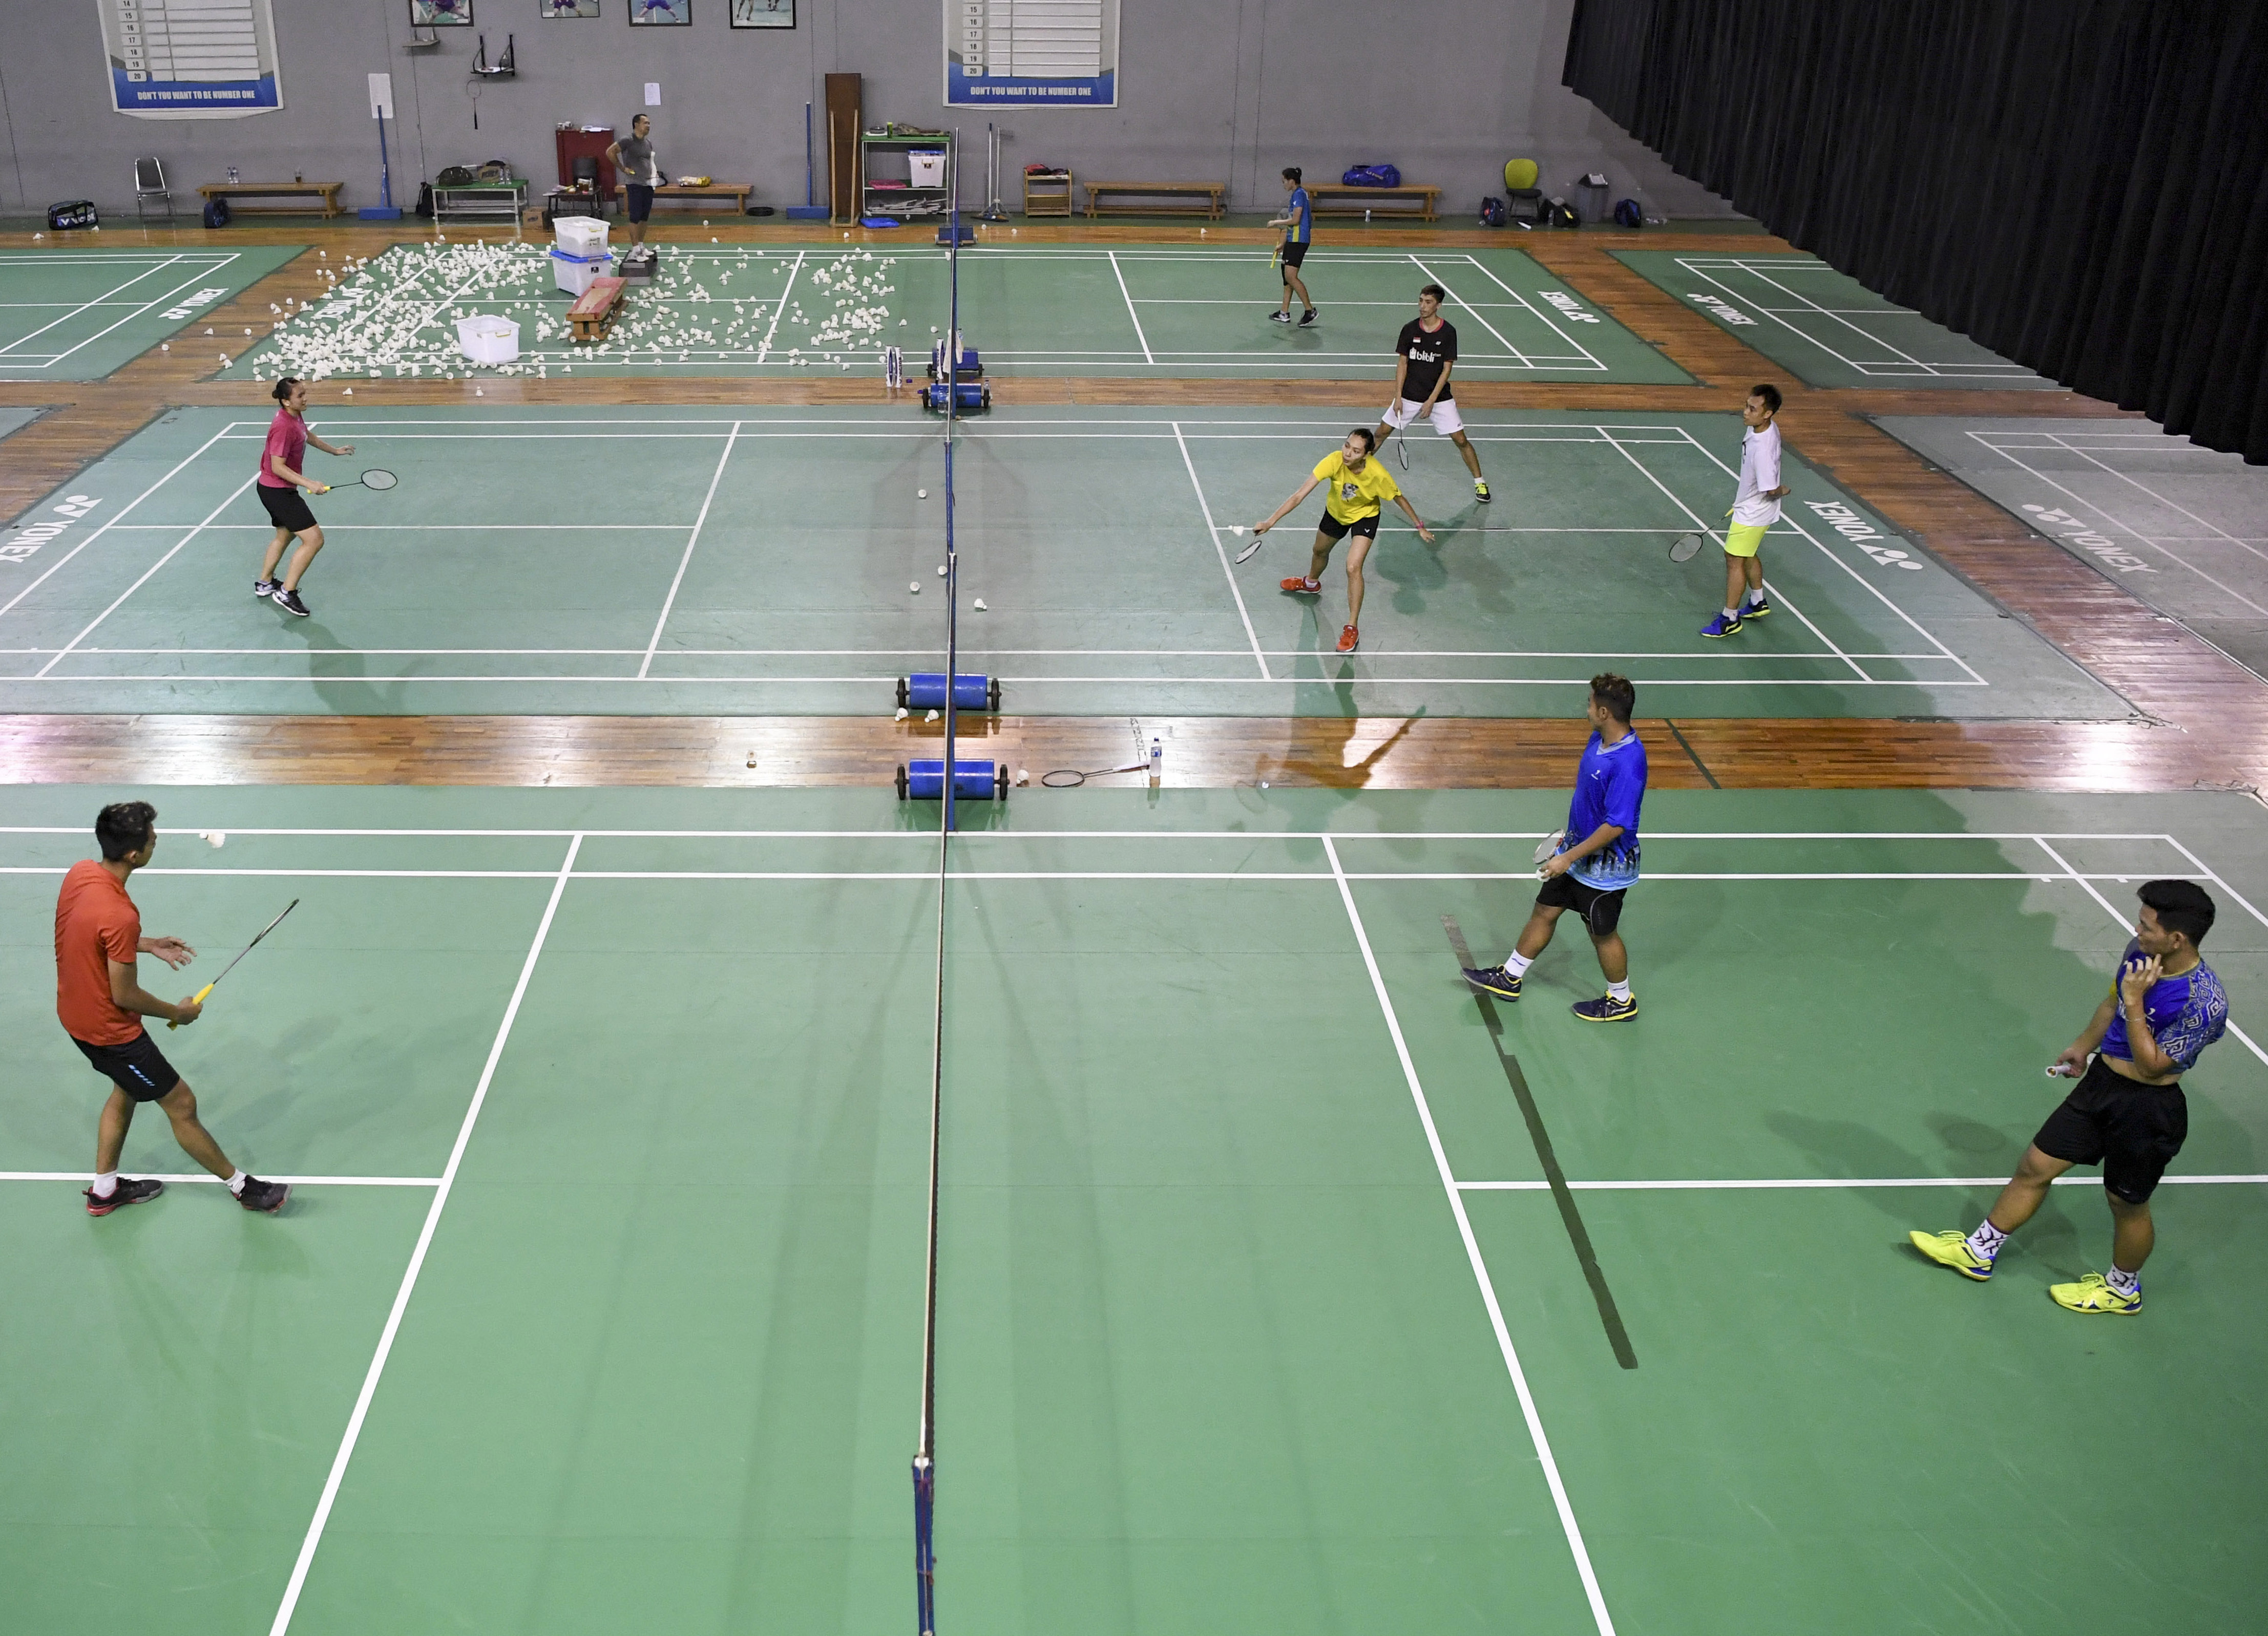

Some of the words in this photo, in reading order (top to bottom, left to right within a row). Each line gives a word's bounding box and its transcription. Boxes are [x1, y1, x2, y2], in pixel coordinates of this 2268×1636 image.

[158, 92, 172, 100] YOU
[172, 91, 192, 100] WANT
[193, 91, 202, 99] TO
[203, 91, 212, 99] BE
[213, 91, 241, 99] NUMBER
[242, 90, 255, 99] ONE
[971, 87, 991, 95] DON'T
[992, 87, 1005, 95] YOU
[1006, 87, 1027, 95] WANT
[1028, 87, 1037, 95] TO
[1038, 87, 1047, 95] BE
[1048, 87, 1077, 96] NUMBER
[1078, 87, 1091, 96] ONE
[175, 288, 229, 307] YONEX
[1537, 291, 1583, 310] YONEX
[1706, 305, 1759, 325] YONEX
[1803, 501, 1885, 542] YONEX
[0, 520, 76, 563] YONEX
[2063, 530, 2159, 573] YONEX
